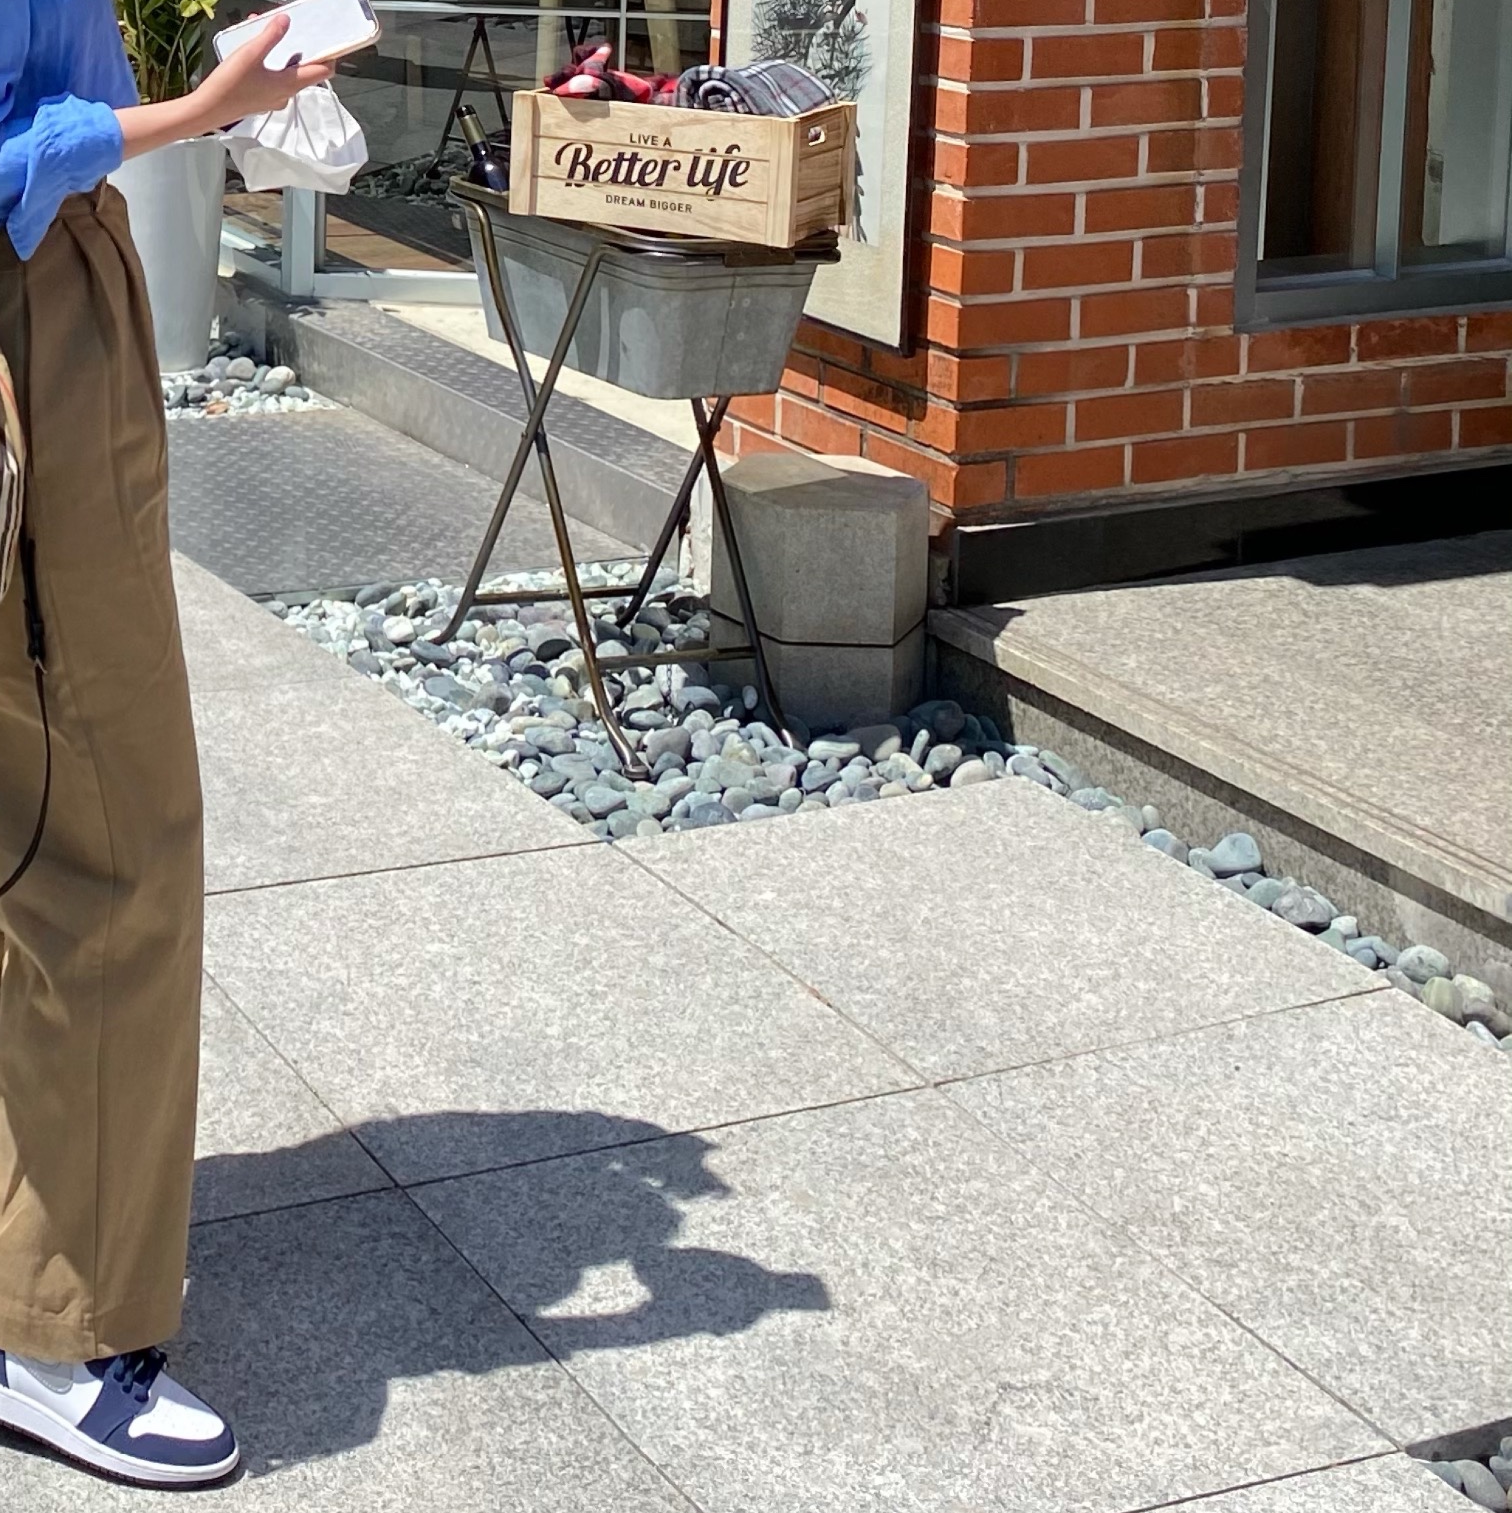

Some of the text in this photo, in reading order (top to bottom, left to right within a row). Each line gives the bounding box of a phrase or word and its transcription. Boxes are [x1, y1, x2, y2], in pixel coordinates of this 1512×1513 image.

[629, 133, 673, 148] LIVE A
[554, 141, 681, 188] Better
[605, 193, 693, 214] DREAM BIGGER
